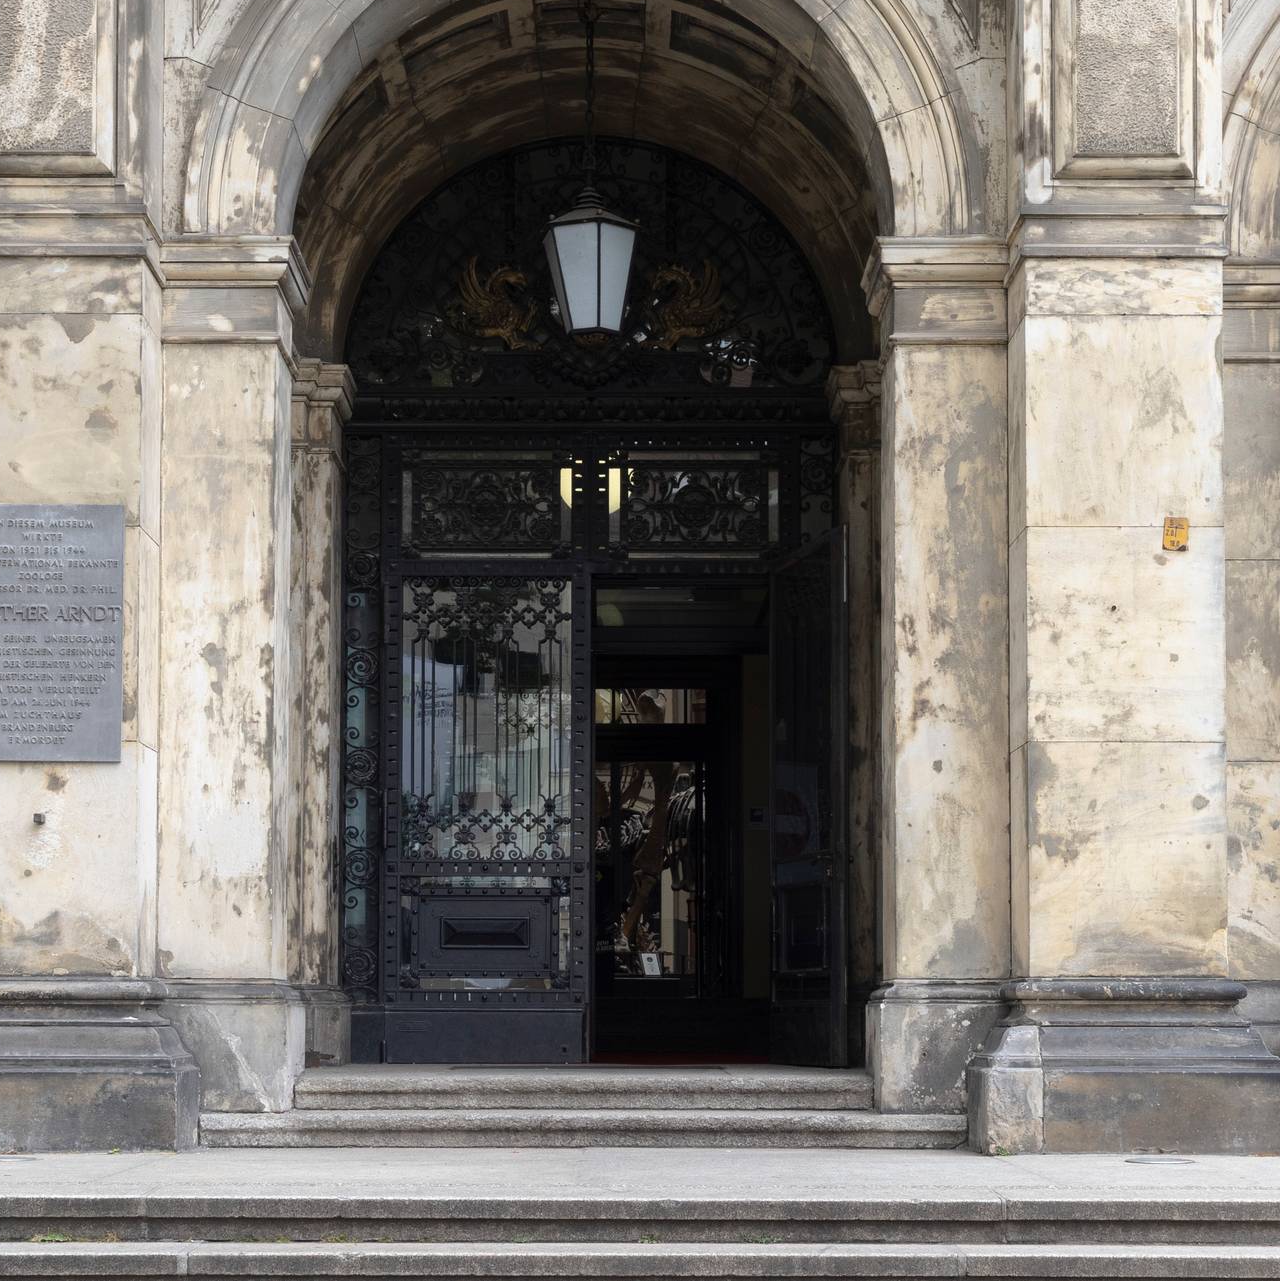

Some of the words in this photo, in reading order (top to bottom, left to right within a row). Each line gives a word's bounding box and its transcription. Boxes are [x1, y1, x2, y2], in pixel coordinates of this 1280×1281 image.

[7, 519, 44, 528] DIESEM
[49, 519, 94, 528] MUSEUM
[22, 533, 63, 542] WIRKTE
[18, 572, 64, 581] ZOOLOGE
[55, 604, 122, 622] ARNDT
[1, 724, 74, 733] BRANDENBURG
[8, 736, 66, 745] ERMORDET
